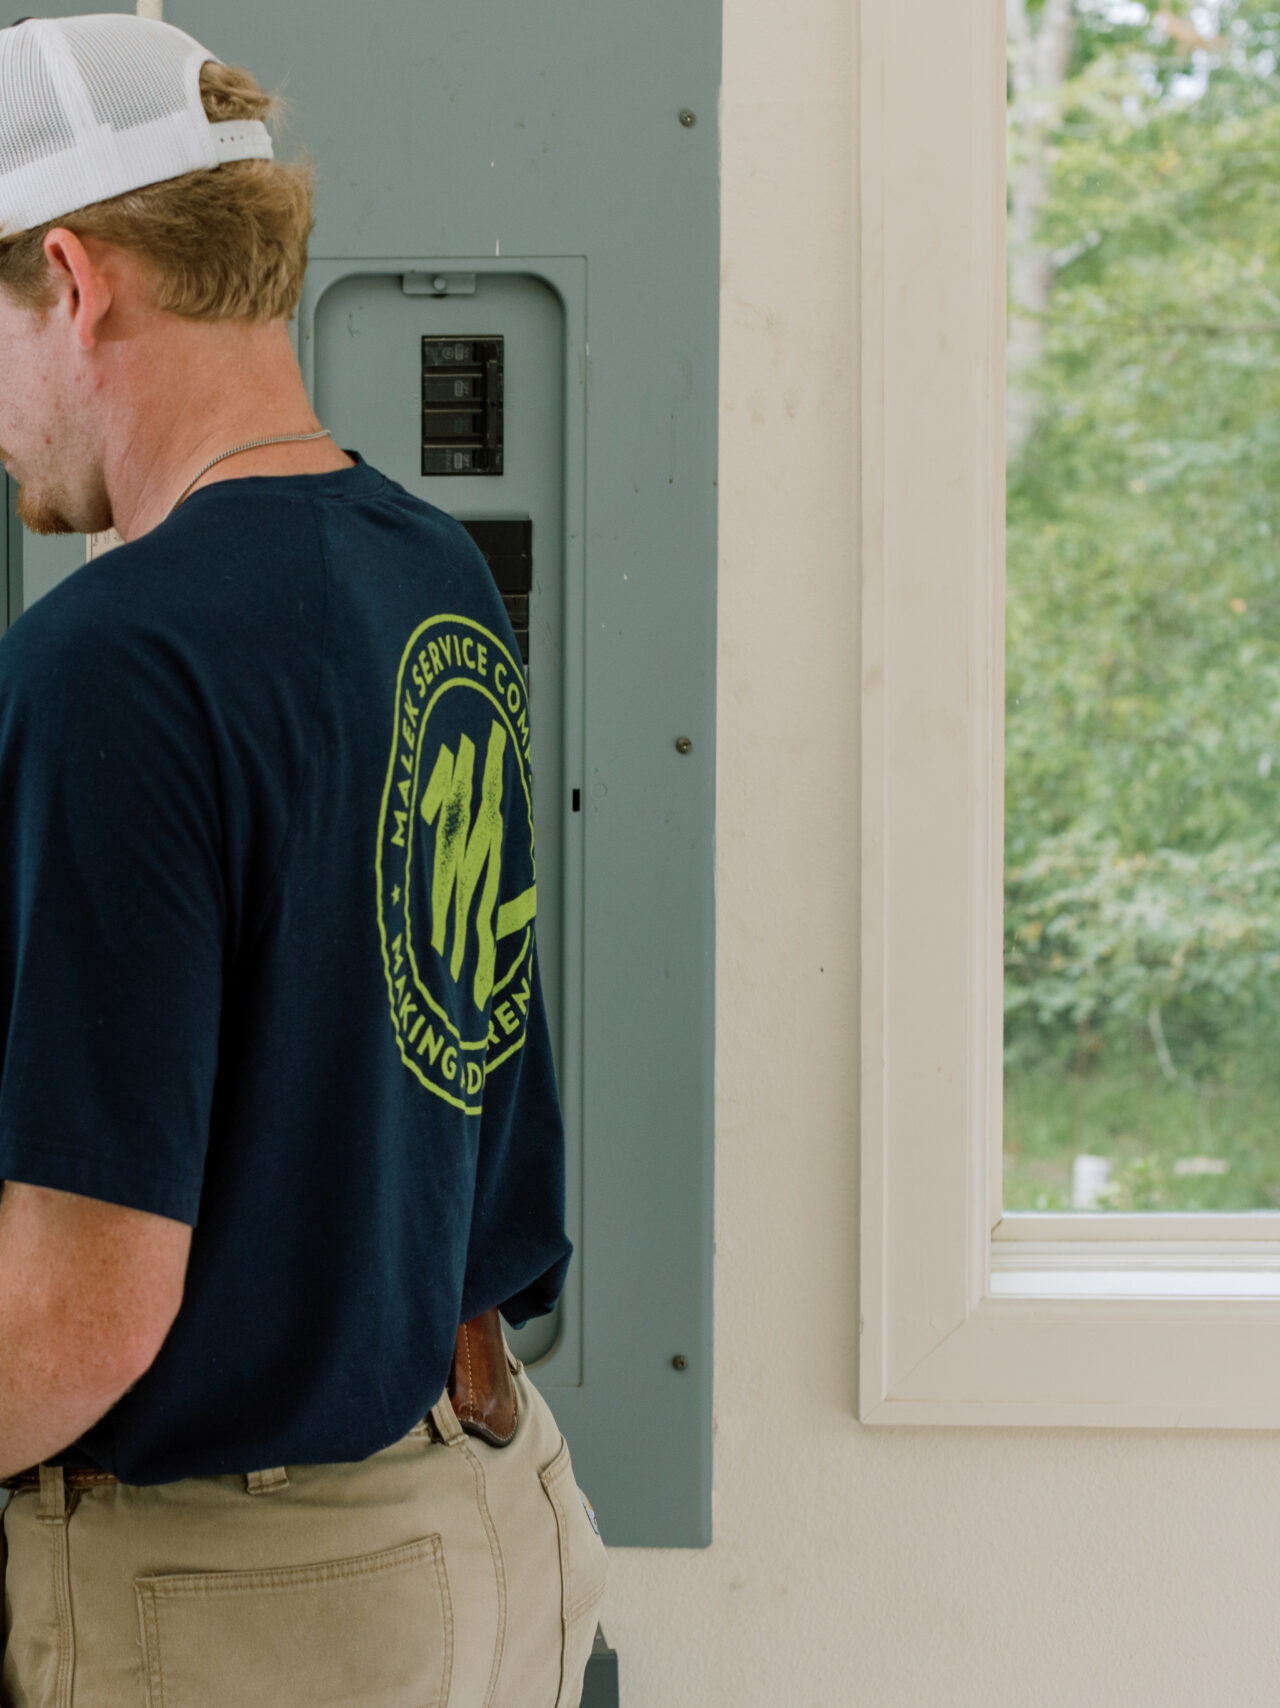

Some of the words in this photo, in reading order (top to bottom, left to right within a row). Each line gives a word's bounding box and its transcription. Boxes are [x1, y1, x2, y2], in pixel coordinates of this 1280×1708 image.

[391, 689, 420, 848] MALEK
[411, 634, 488, 698] SERVICE
[391, 932, 458, 1081] MAKING
